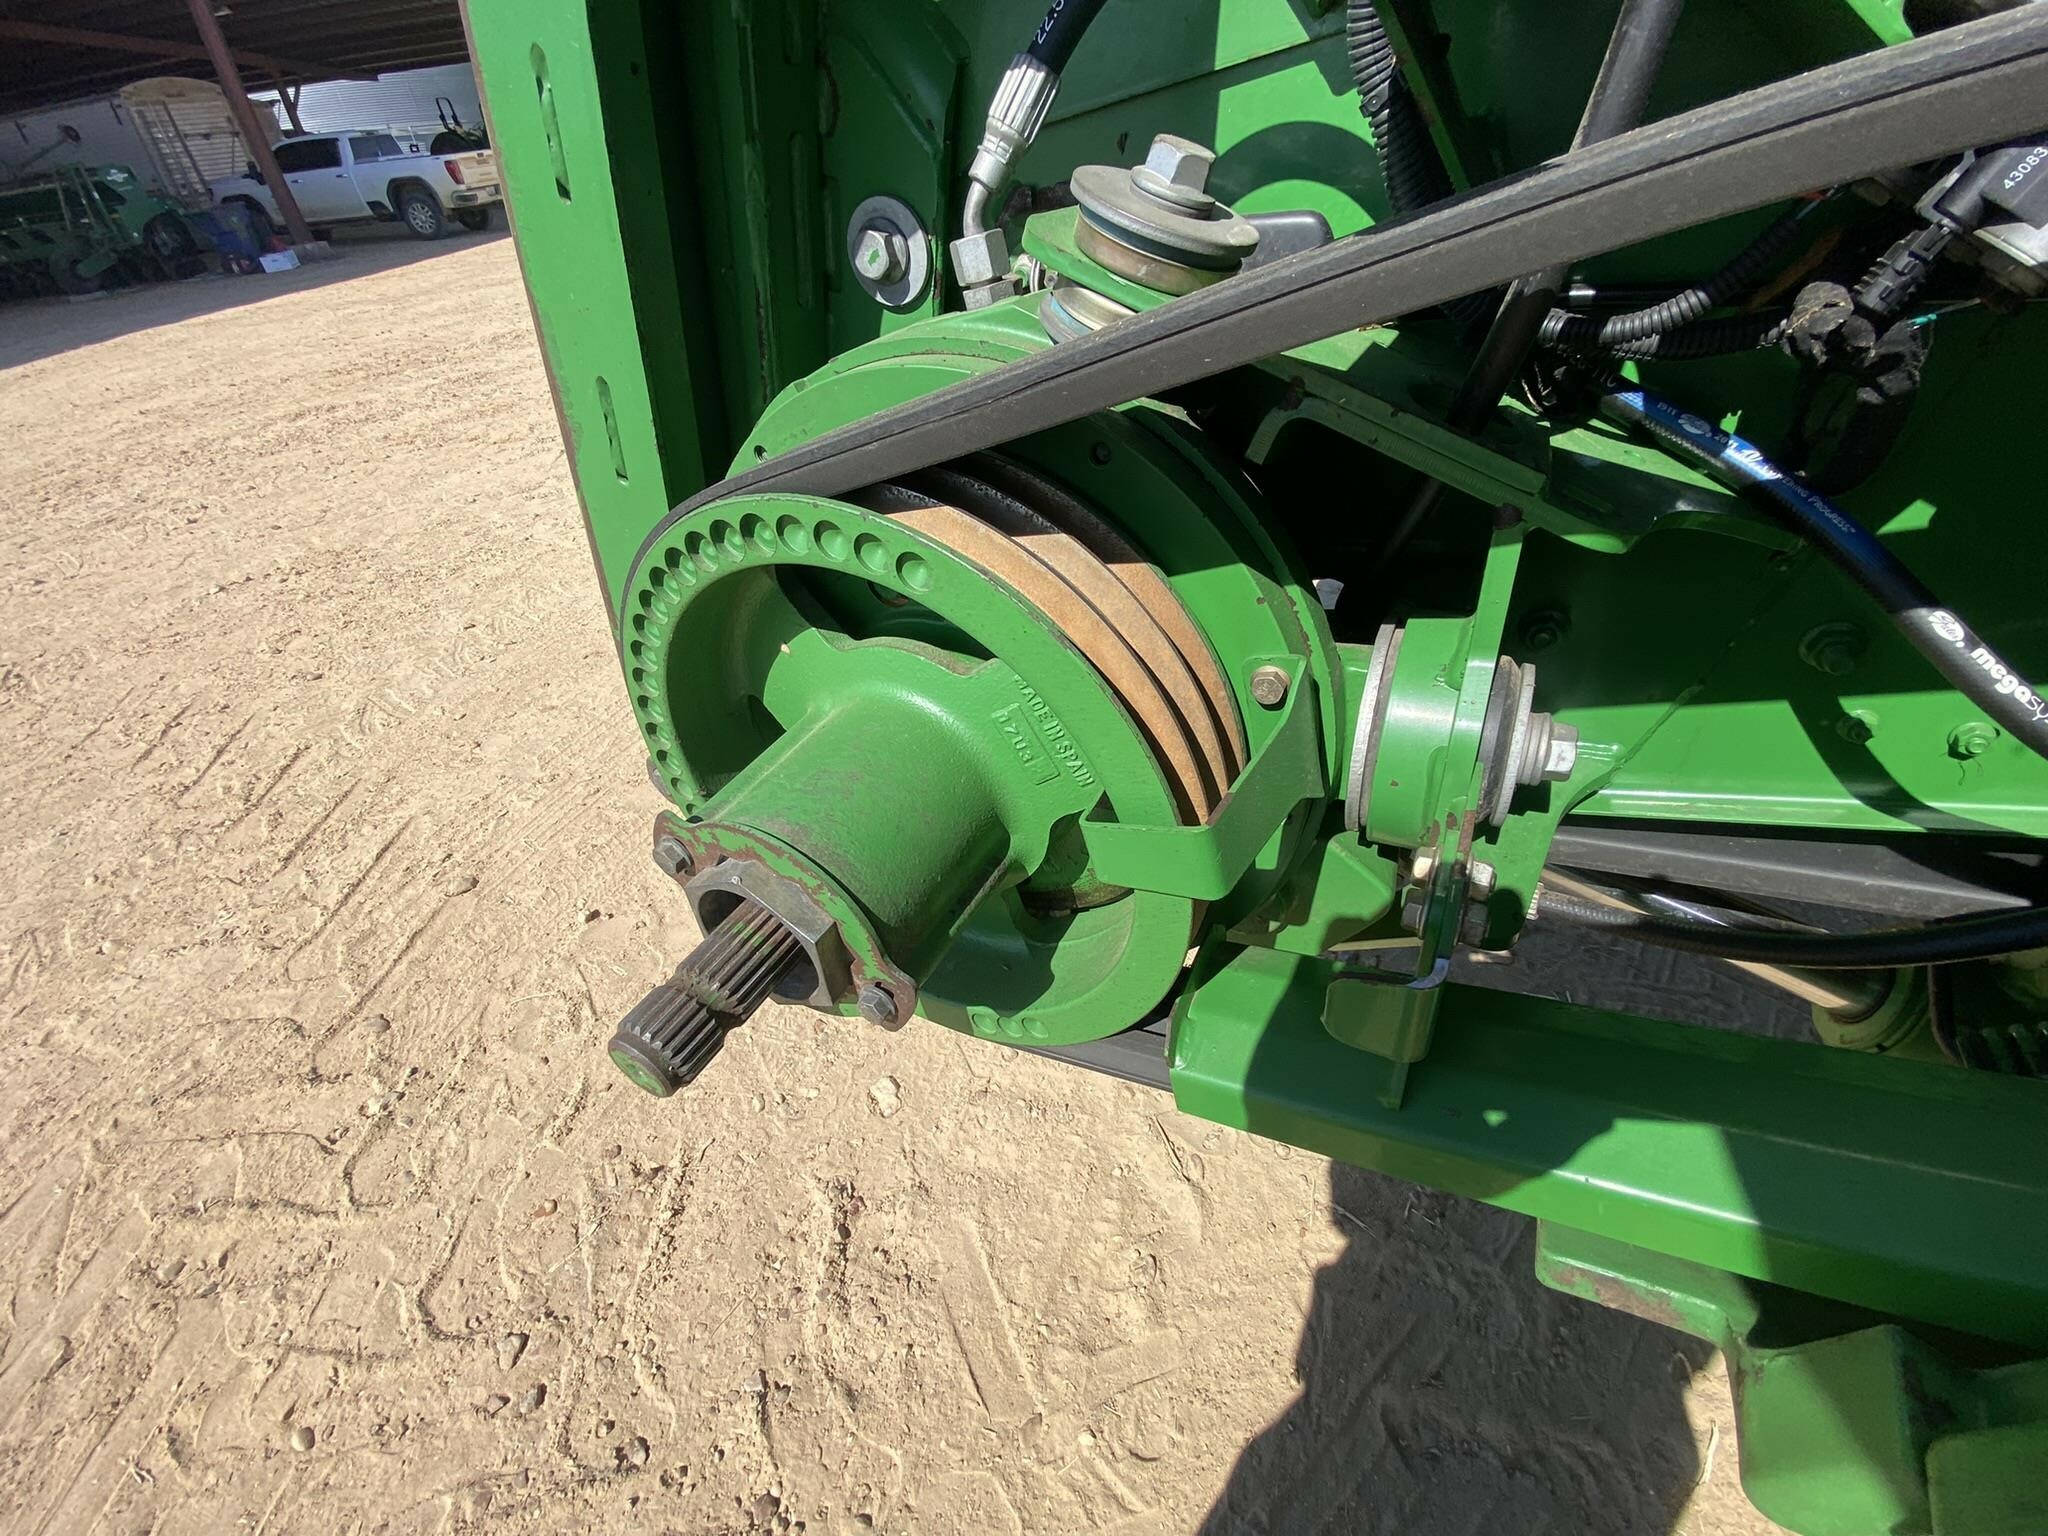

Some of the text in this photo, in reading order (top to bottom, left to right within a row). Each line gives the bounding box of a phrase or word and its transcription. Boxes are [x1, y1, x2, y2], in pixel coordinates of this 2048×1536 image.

[2003, 146, 2048, 190] 43083
[1970, 647, 2048, 724] megasy
[1014, 674, 1095, 788] MADE IN SPAIN
